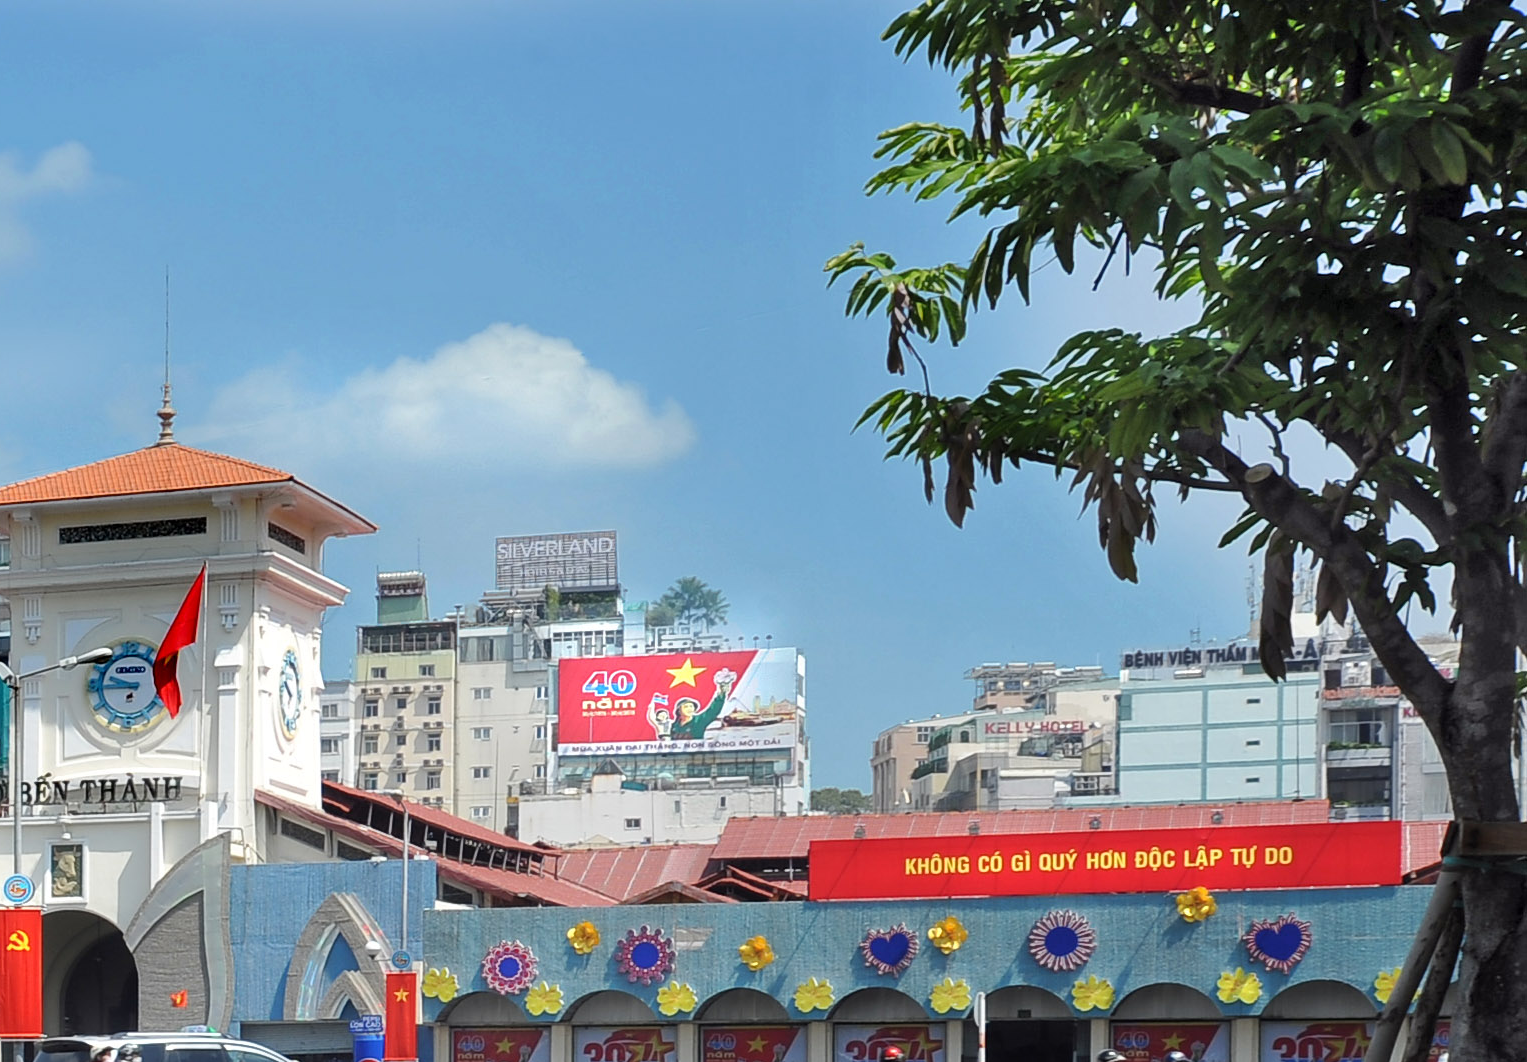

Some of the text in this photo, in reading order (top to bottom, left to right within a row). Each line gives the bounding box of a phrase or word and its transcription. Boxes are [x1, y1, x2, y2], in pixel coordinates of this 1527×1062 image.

[497, 538, 613, 559] SILVERLAND
[1124, 650, 1163, 673] BỆNH
[1167, 647, 1201, 667] VIỆN
[582, 670, 637, 697] 40
[582, 697, 637, 710] năm
[985, 720, 1089, 735] KELLY HOTEL
[22, 772, 70, 804] BẾN
[80, 772, 183, 803] THÀNH
[905, 845, 1292, 875] KHÔNG CÓ GÌ QUÝ HƠN ĐỘC LẬP TỰ DO
